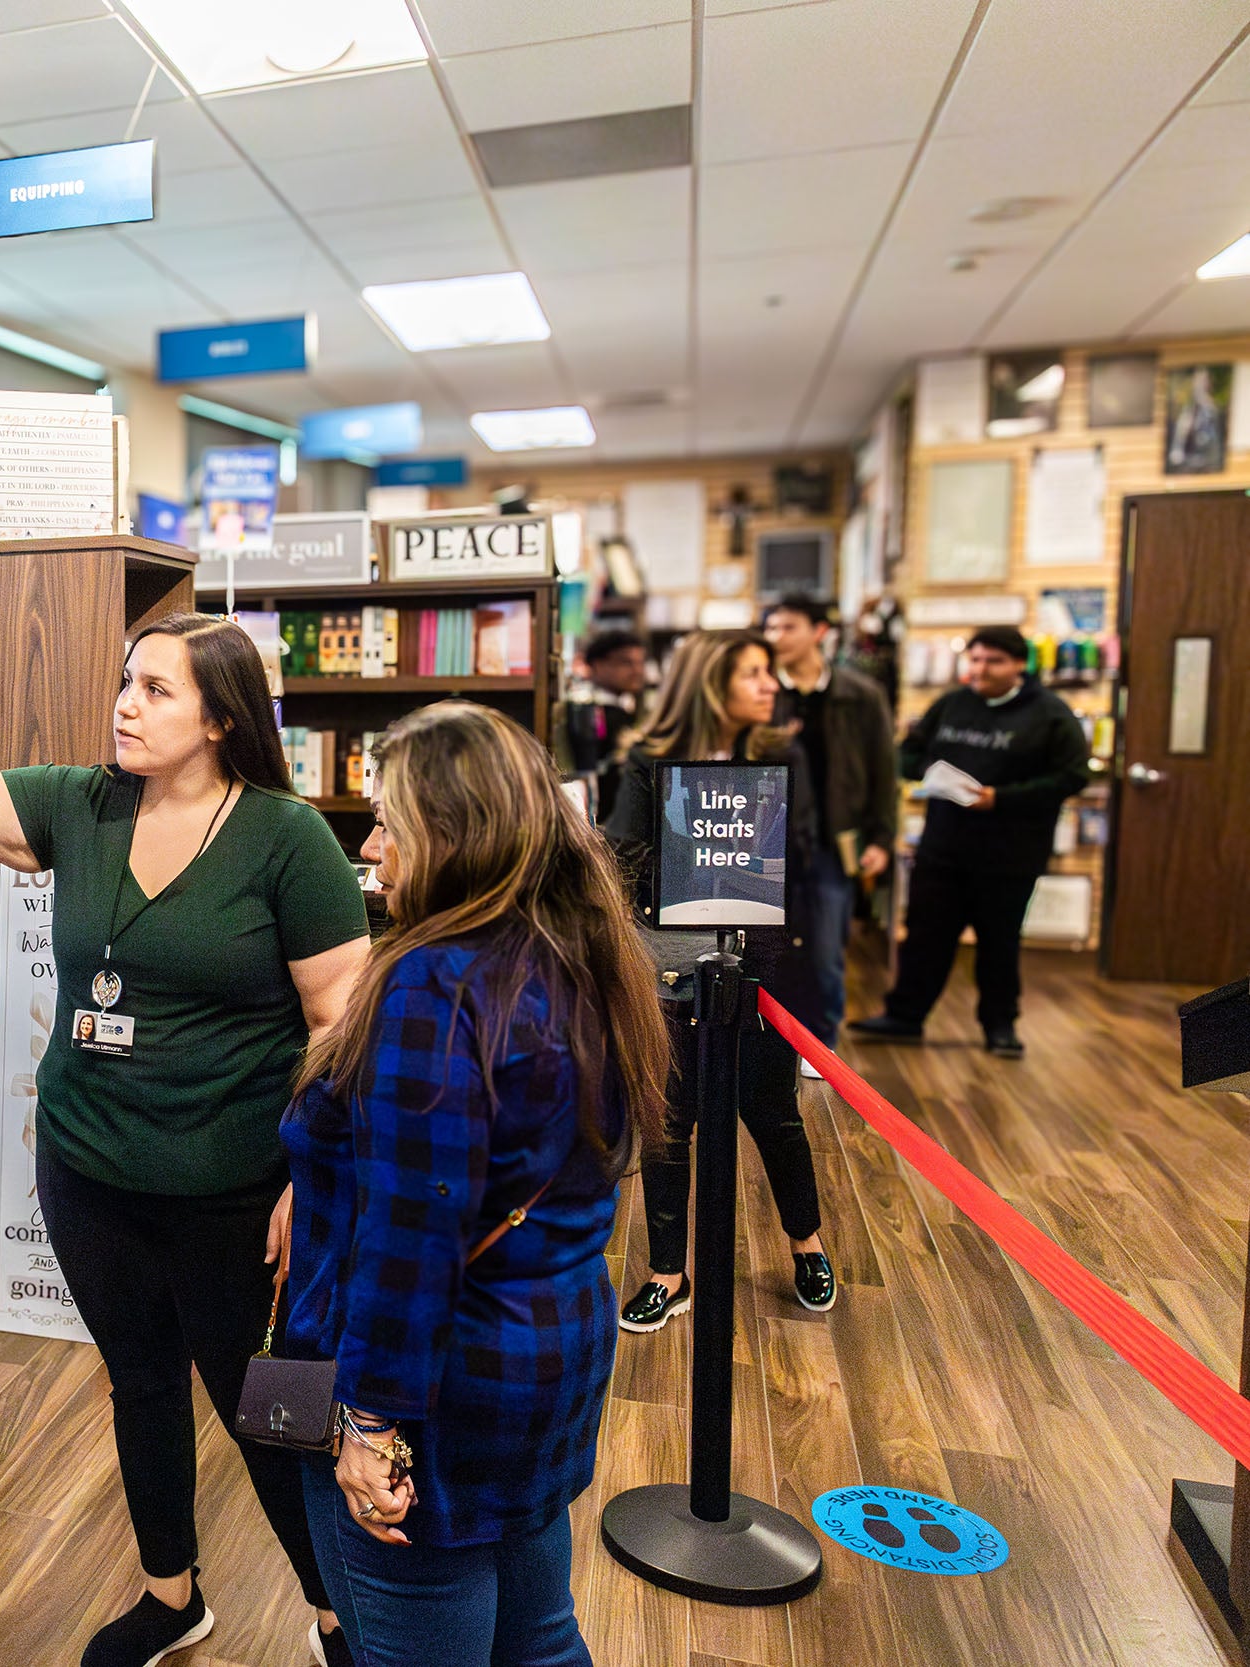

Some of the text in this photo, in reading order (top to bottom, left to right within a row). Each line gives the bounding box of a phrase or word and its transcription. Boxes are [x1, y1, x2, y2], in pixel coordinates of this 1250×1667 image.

[10, 179, 85, 203] EQUIPPING
[288, 533, 344, 565] goal
[396, 523, 539, 561] PEACE
[701, 790, 747, 810] Line
[692, 819, 754, 838] Starts
[696, 848, 750, 867] Here
[34, 1257, 54, 1268] AND
[827, 1490, 962, 1517] STAND HERE
[825, 1520, 999, 1571] SOCIAL DISTANCING
